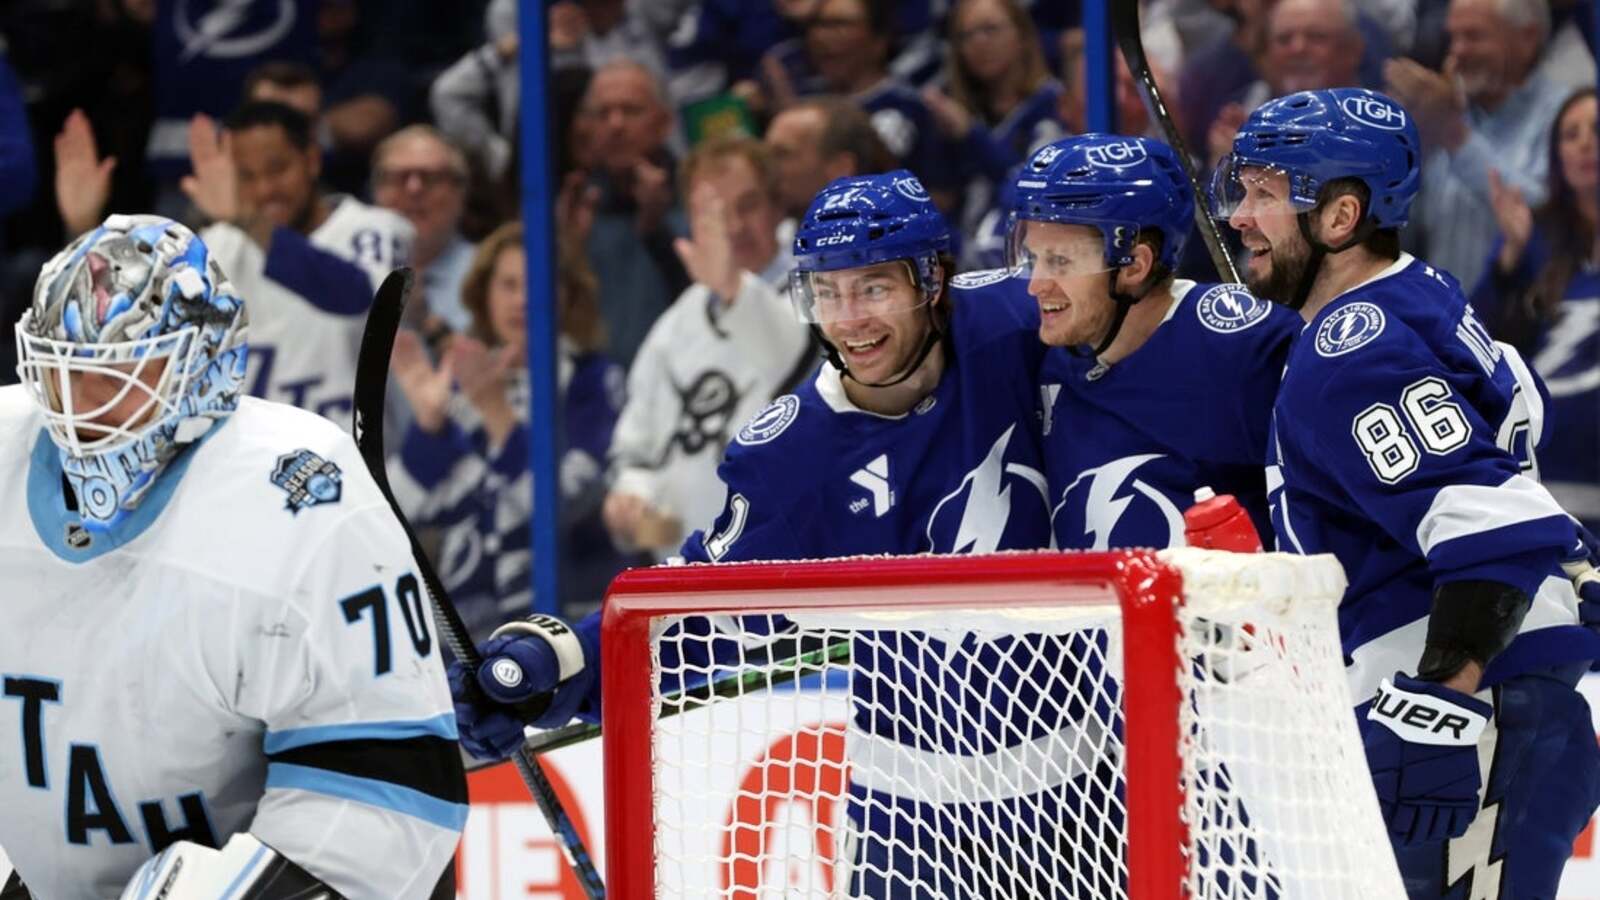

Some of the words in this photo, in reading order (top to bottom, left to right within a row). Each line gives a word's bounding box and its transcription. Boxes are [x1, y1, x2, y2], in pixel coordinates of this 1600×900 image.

[1350, 97, 1406, 128] TGH
[1087, 141, 1147, 163] TGH
[898, 177, 926, 197] TG
[816, 234, 856, 247] CCM
[1352, 376, 1473, 485] 86
[849, 497, 870, 514] the
[338, 572, 432, 678] 70
[1372, 688, 1471, 740] UER
[2, 673, 224, 858] TAH
